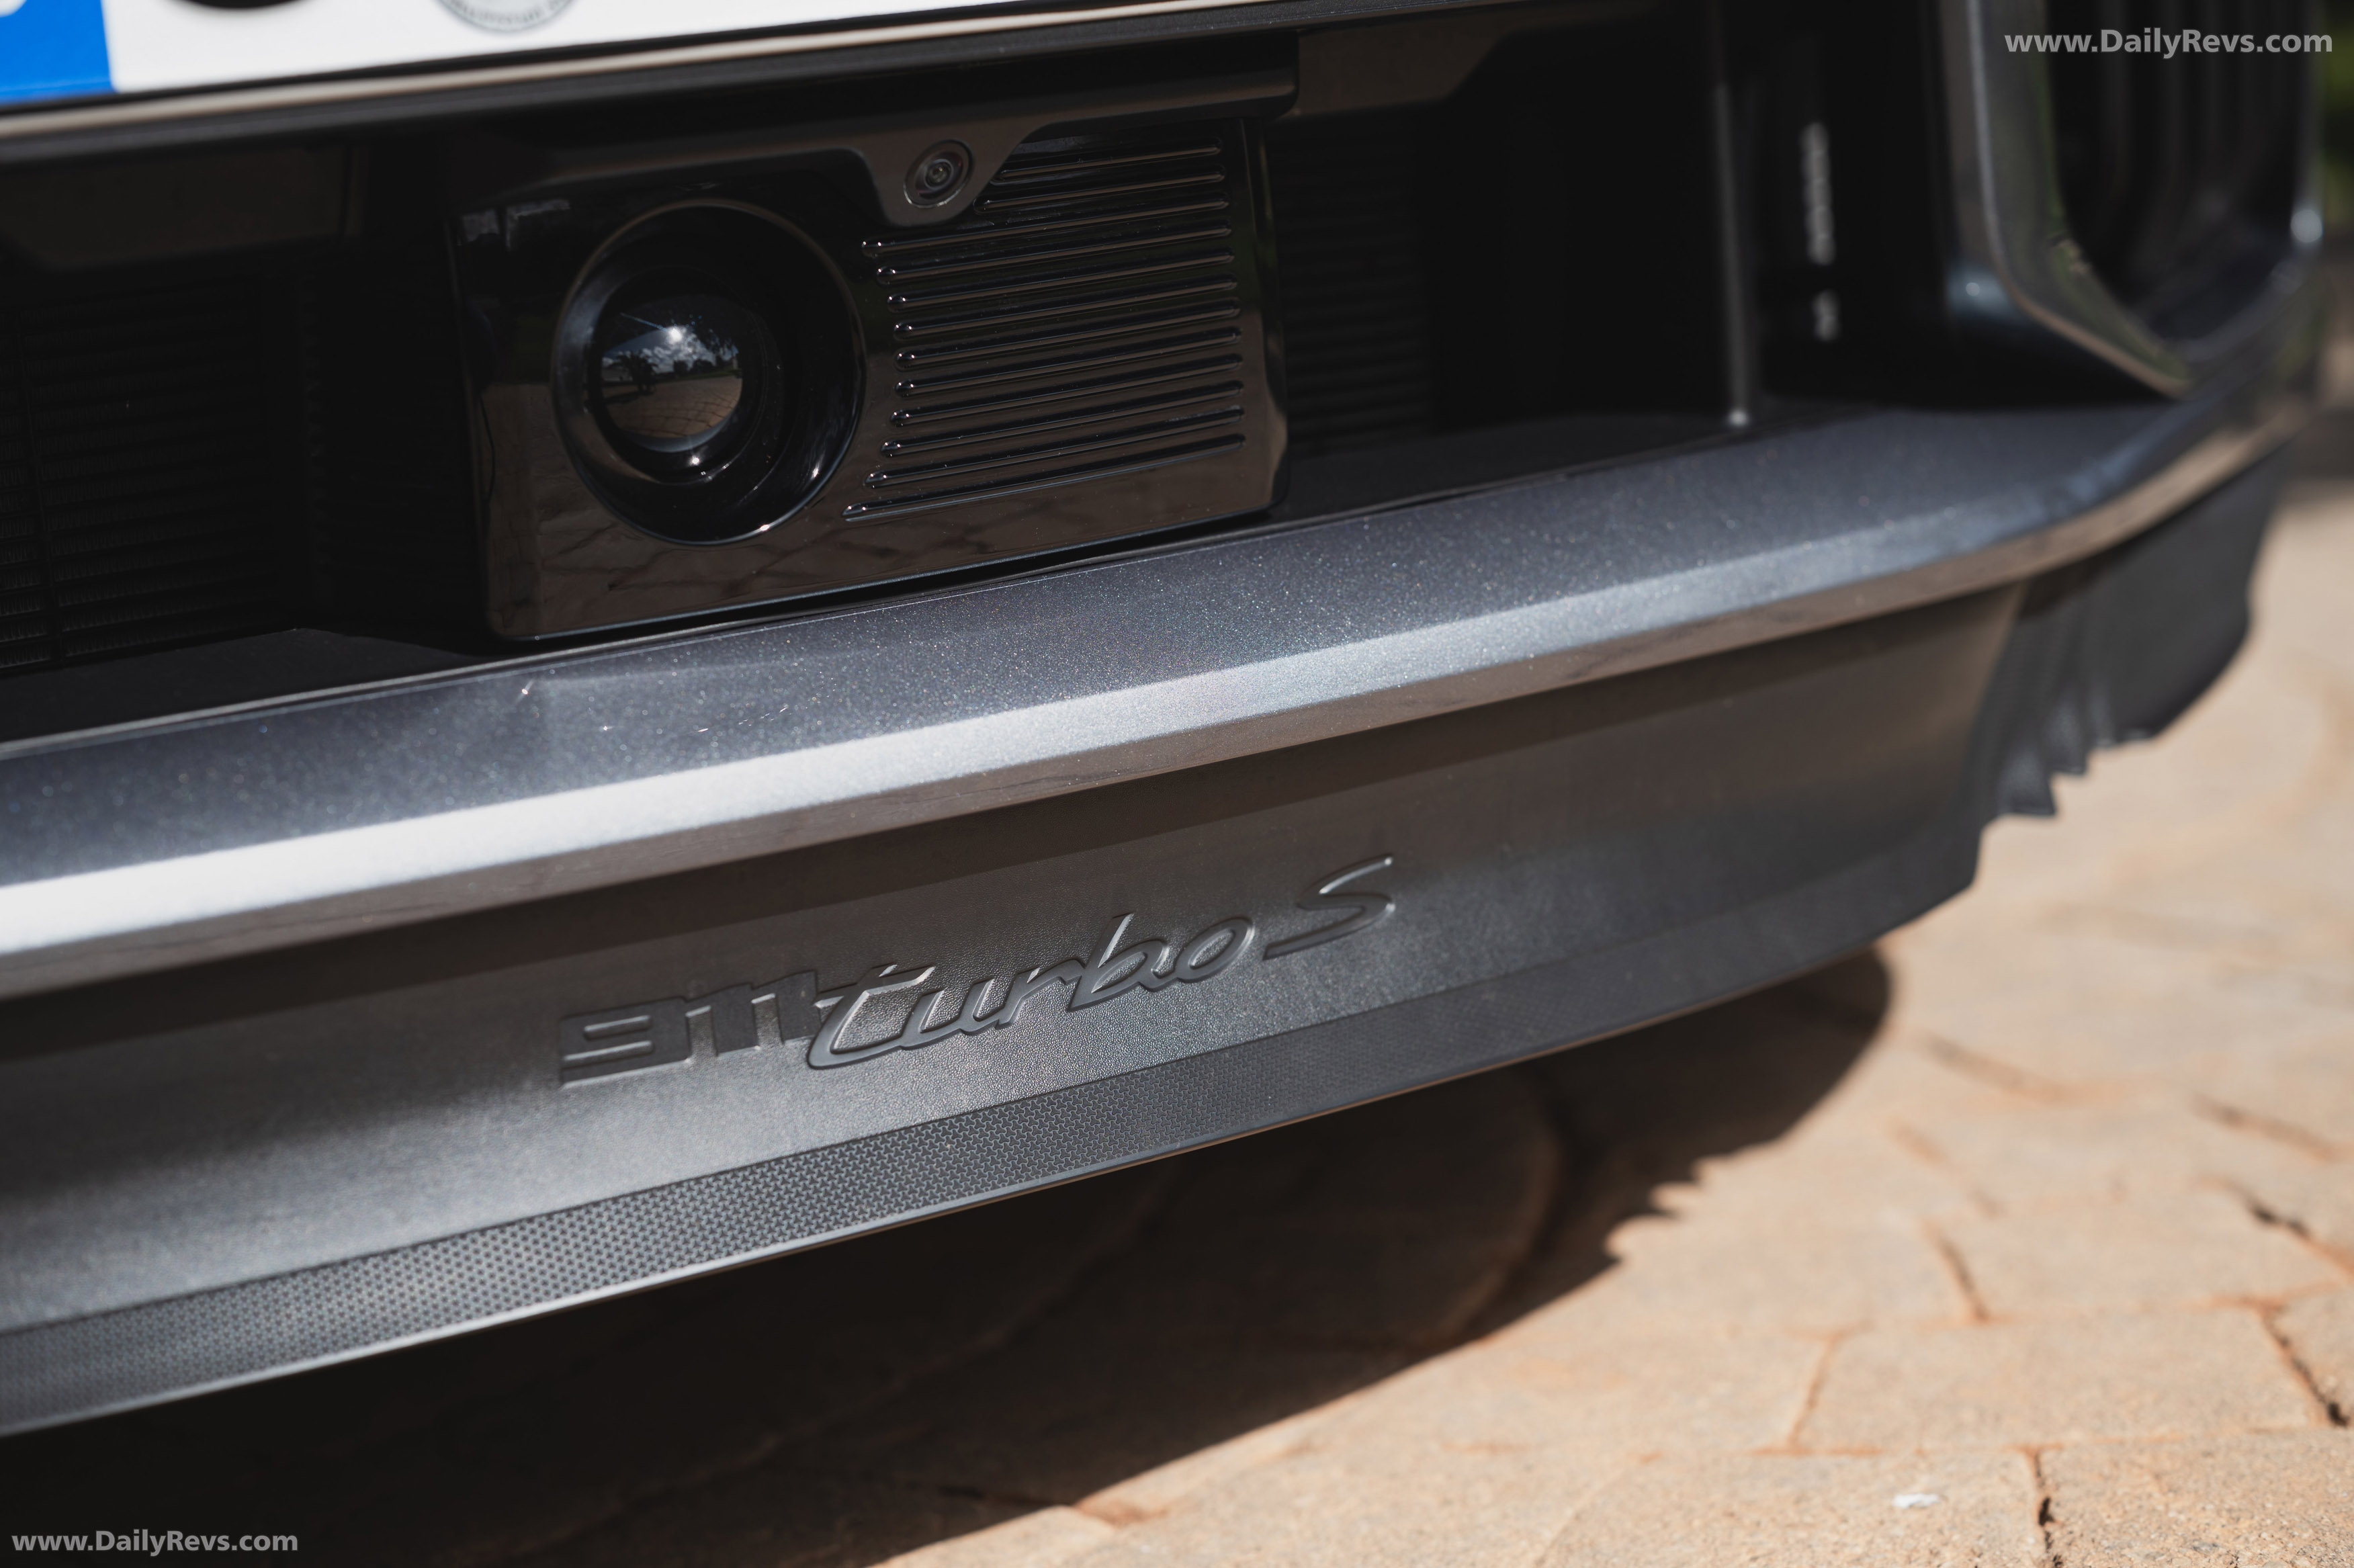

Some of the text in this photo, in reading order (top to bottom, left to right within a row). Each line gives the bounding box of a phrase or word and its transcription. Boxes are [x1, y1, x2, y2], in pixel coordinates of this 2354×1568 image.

[559, 853, 1395, 1088] 911 turbo S
